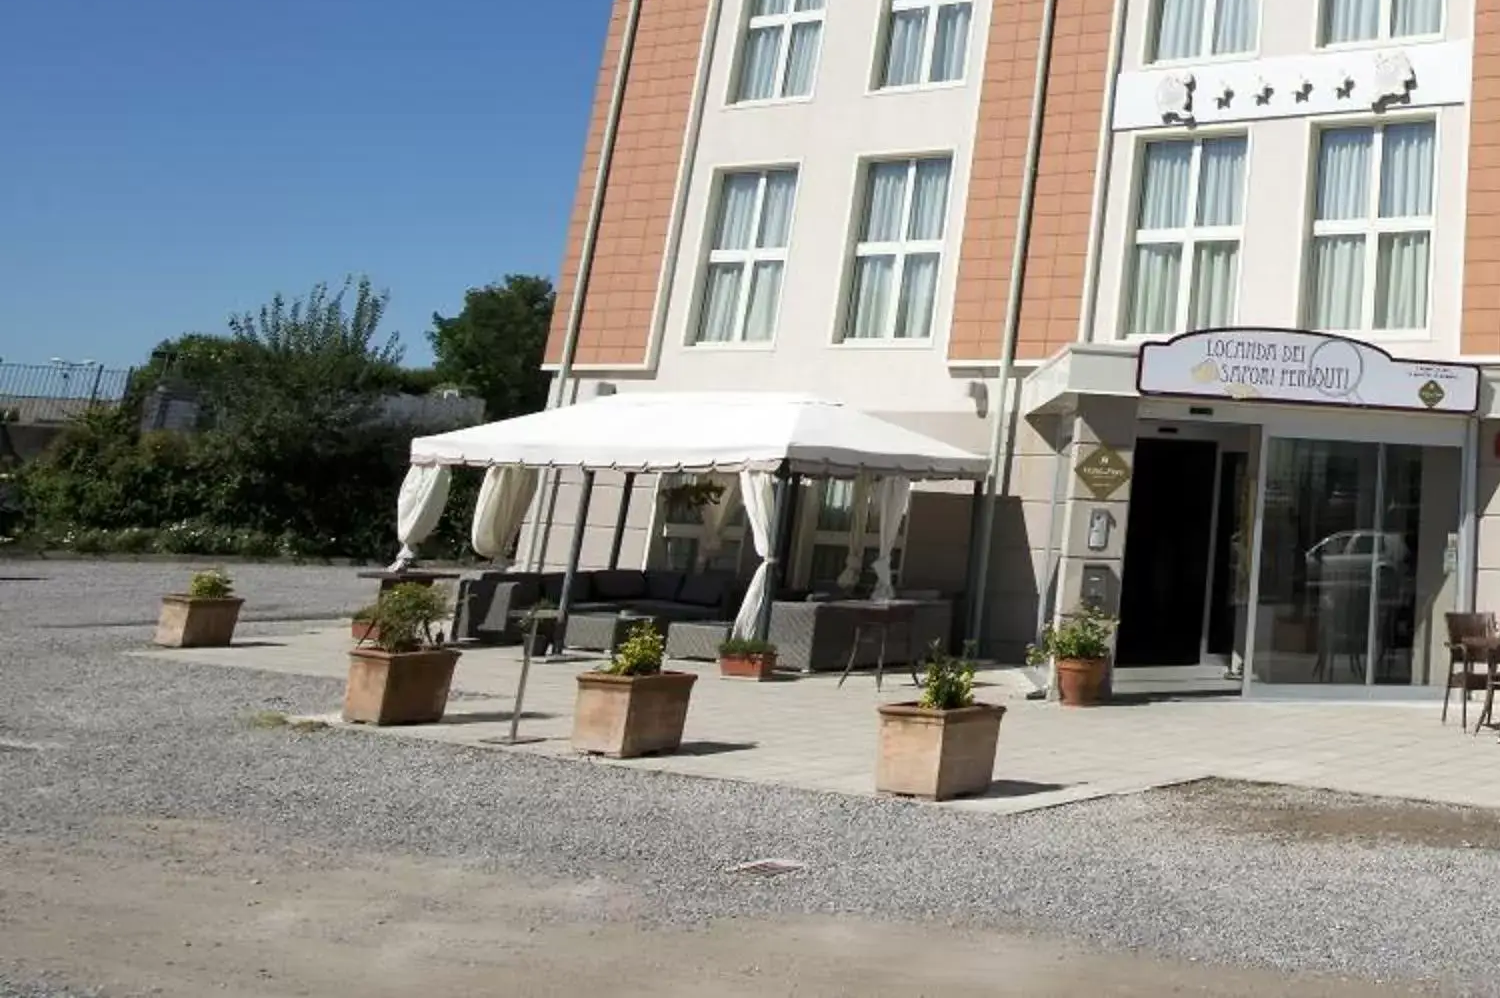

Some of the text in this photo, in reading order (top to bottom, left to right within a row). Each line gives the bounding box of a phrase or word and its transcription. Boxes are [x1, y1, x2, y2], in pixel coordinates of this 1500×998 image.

[1207, 339, 1305, 363] LOCANDA DEI
[1220, 363, 1350, 389] SAPORI PERDUTI
